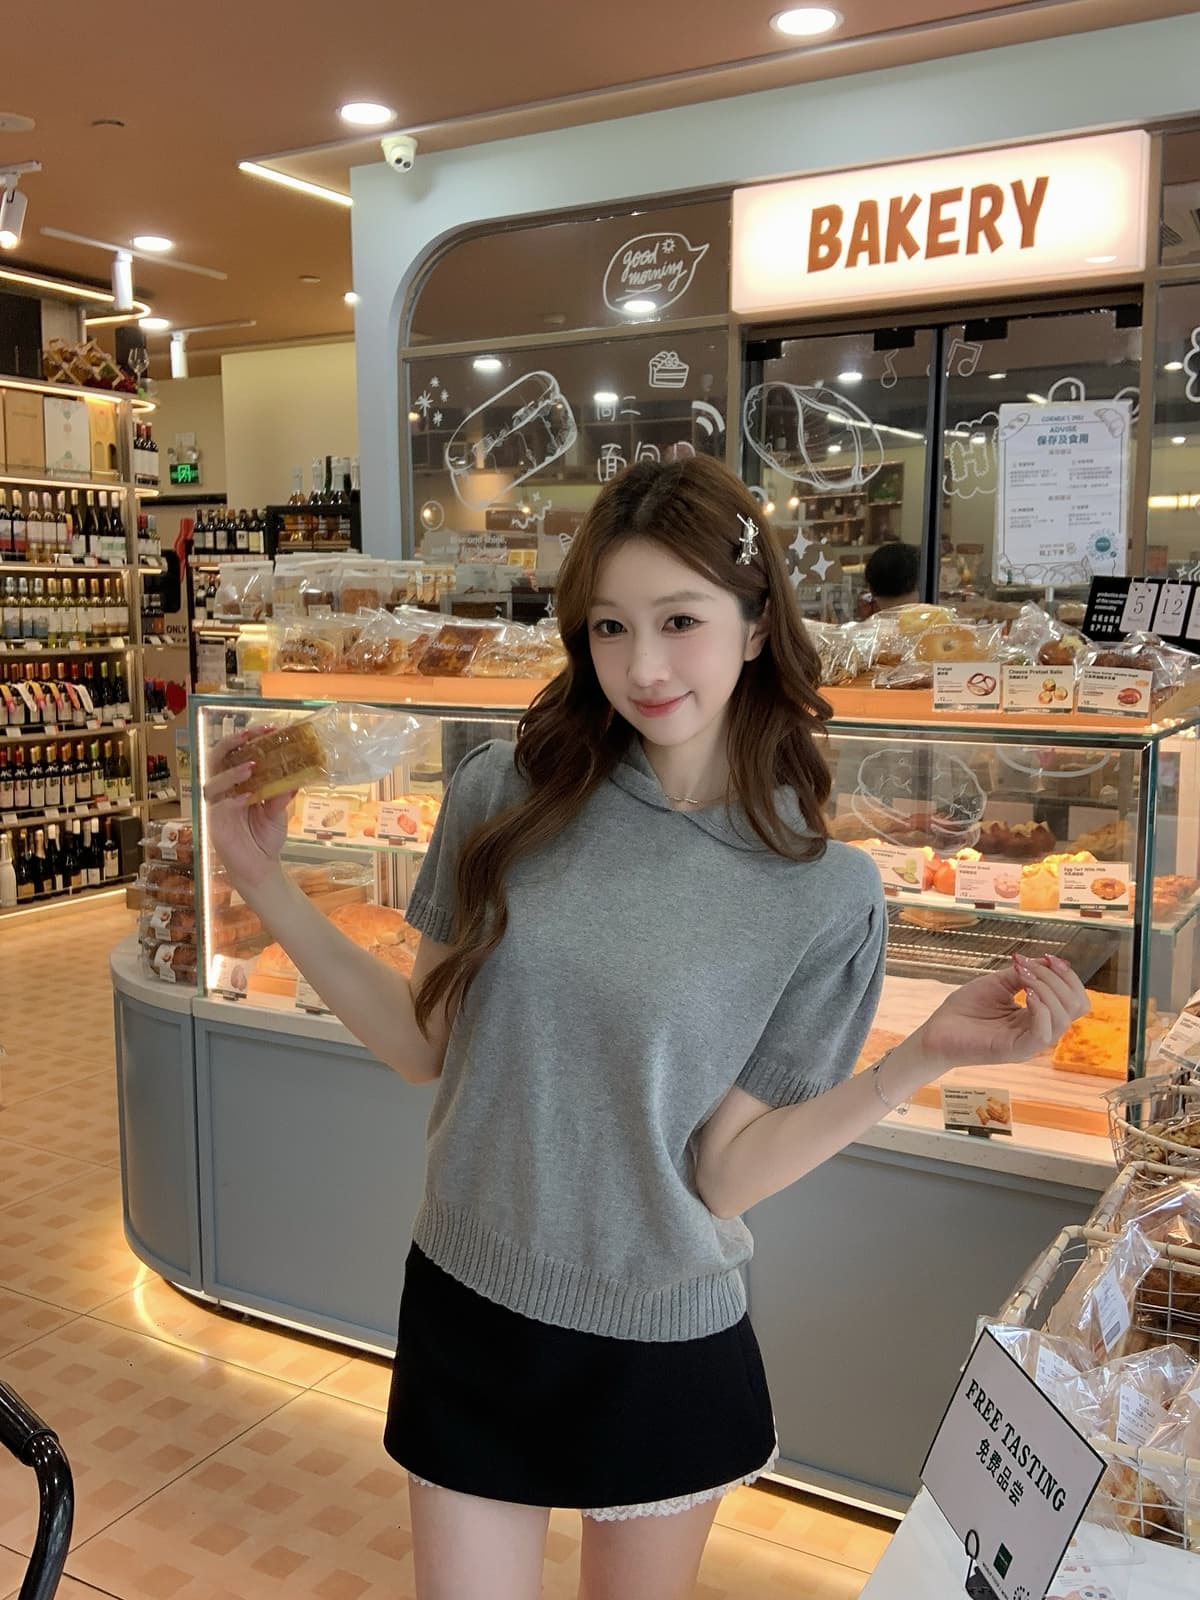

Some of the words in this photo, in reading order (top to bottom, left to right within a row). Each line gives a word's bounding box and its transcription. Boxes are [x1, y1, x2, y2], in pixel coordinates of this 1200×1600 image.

[807, 176, 1049, 273] BAKERY
[621, 241, 660, 282] good
[629, 261, 687, 292] morning
[1037, 433, 1089, 446] 保存及食用
[1049, 425, 1077, 433] ADVISE
[1134, 595, 1145, 615] 5
[1163, 598, 1183, 616] 12
[166, 625, 187, 634] ONLY
[965, 1379, 1003, 1432] FREE
[1001, 1423, 1066, 1512] TASTING
[976, 1439, 1024, 1507] 免费品尝
